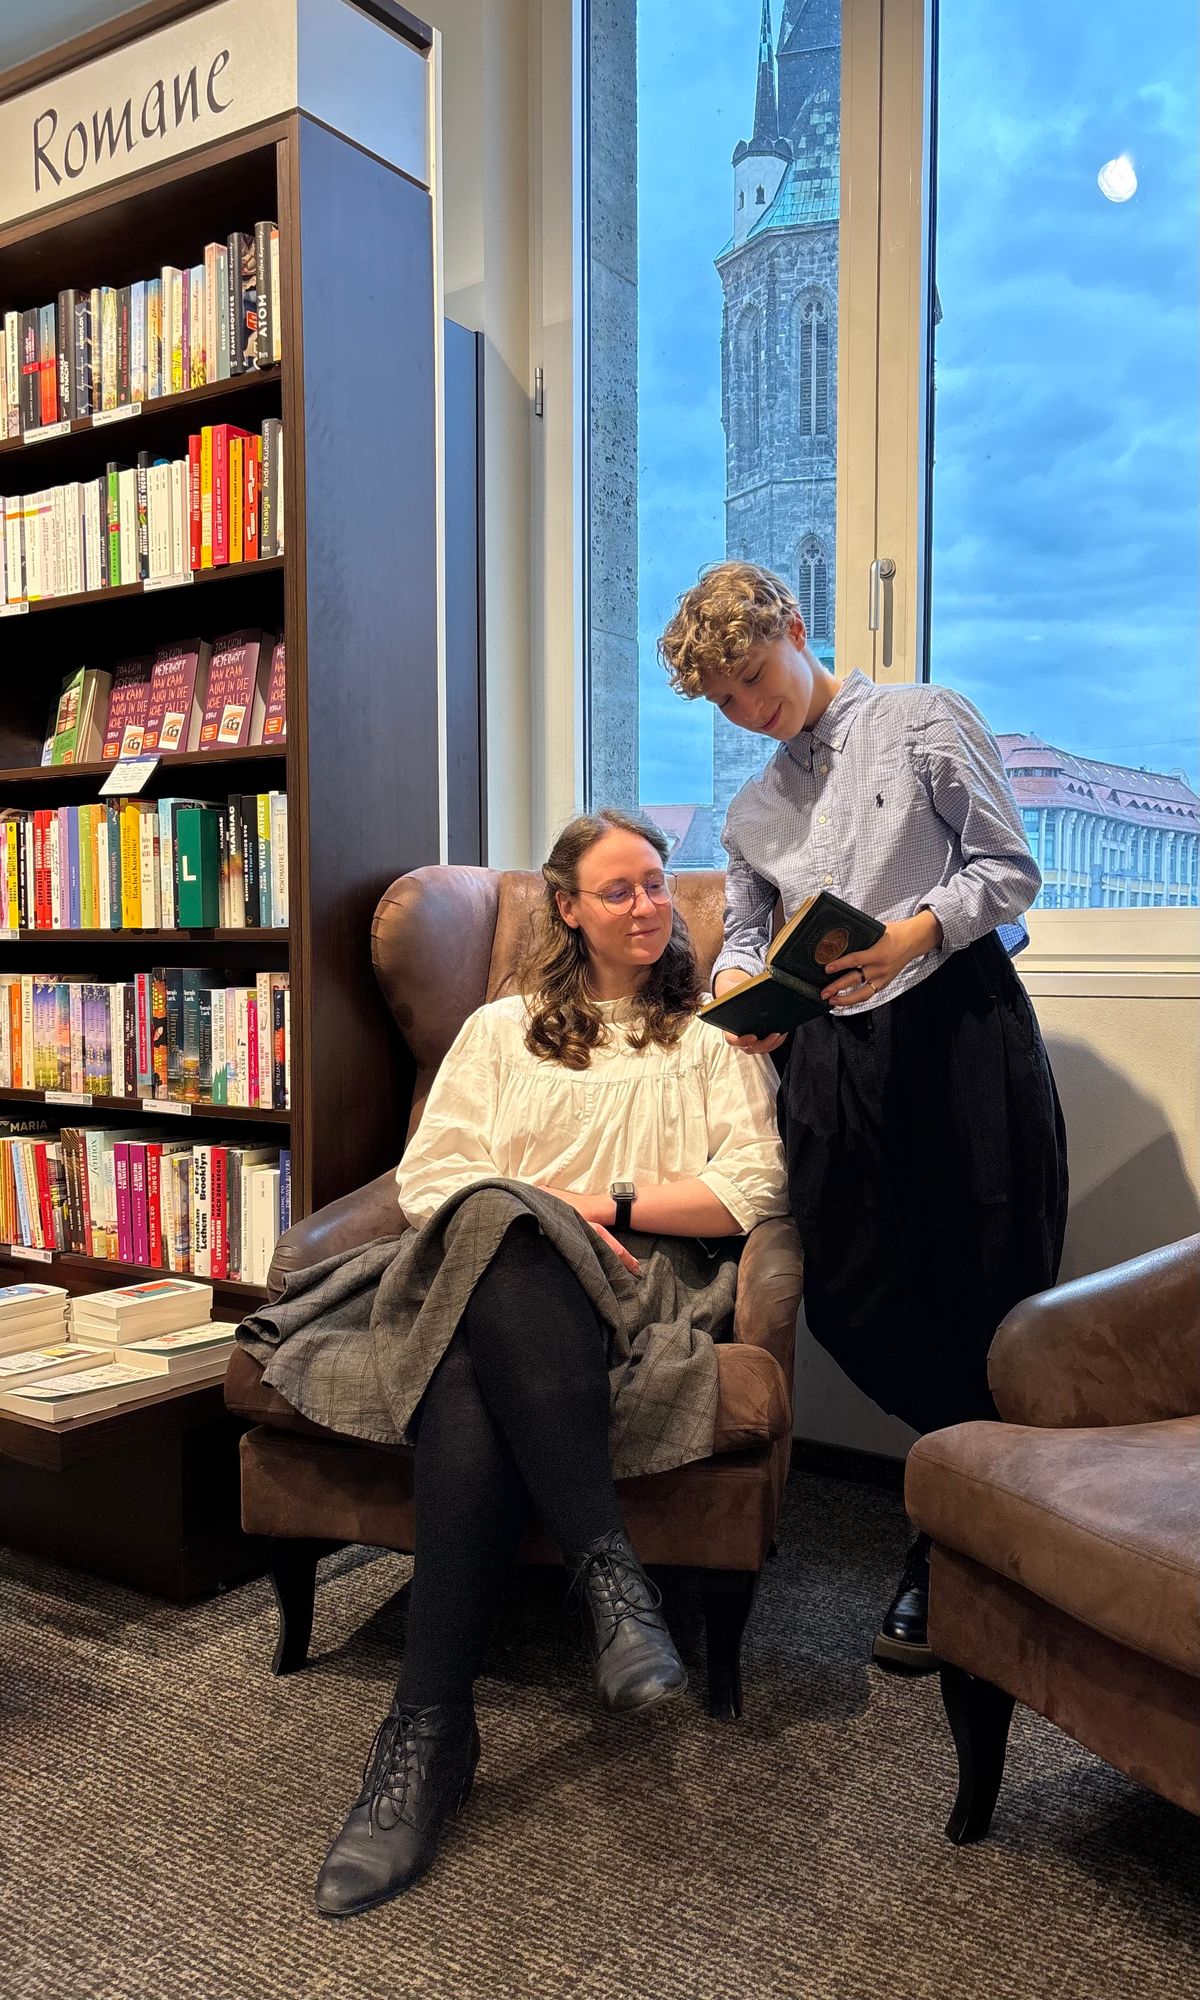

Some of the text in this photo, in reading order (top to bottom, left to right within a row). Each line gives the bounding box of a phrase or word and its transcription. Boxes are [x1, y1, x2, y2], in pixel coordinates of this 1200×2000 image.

[33, 49, 234, 193] Romane
[258, 294, 268, 337] ATOM
[213, 650, 246, 666] MEYERHOFF
[274, 660, 286, 672] MA
[155, 660, 186, 676] MEYERHOFF
[225, 664, 244, 678] KANN
[166, 674, 184, 686] KANN
[209, 677, 250, 696] AUCH IN DIE
[126, 688, 144, 701] KANN
[151, 686, 188, 702] AUCH IN DIE
[224, 693, 250, 706] FALLEN
[110, 700, 148, 716] AUCH IN DIE
[164, 701, 190, 713] FALLEN
[124, 714, 146, 726] FALLE
[258, 838, 266, 868] WILDE
[182, 856, 196, 882] L
[10, 1120, 48, 1132] MARIA
[200, 1152, 208, 1200] Brooklyn
[280, 1185, 285, 1194] TO
